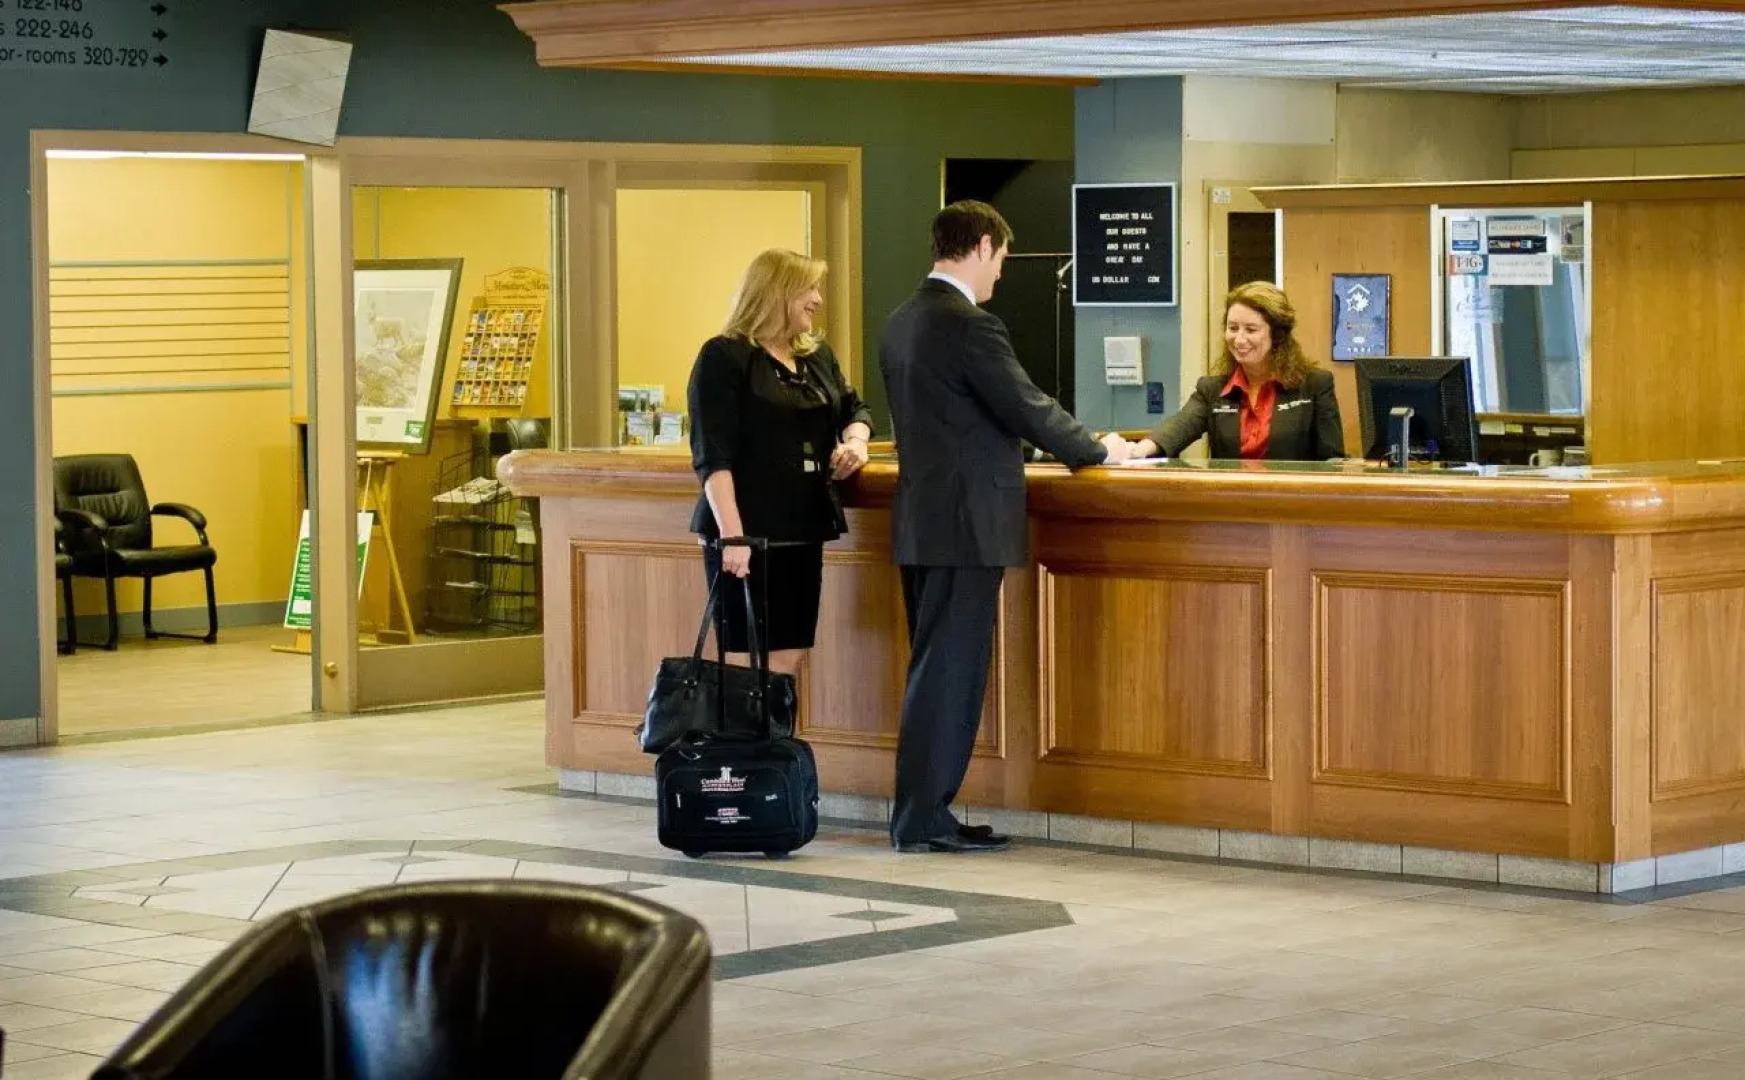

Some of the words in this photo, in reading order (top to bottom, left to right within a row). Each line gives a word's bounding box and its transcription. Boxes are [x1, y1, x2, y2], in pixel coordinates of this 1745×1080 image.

[15, 18, 94, 39] 222-246
[83, 46, 149, 67] 320-729
[1131, 212, 1139, 220] TO
[1141, 212, 1153, 220] ALL
[1121, 227, 1147, 235] GUESTS
[1123, 242, 1141, 250] HAVE
[1145, 242, 1150, 250] A
